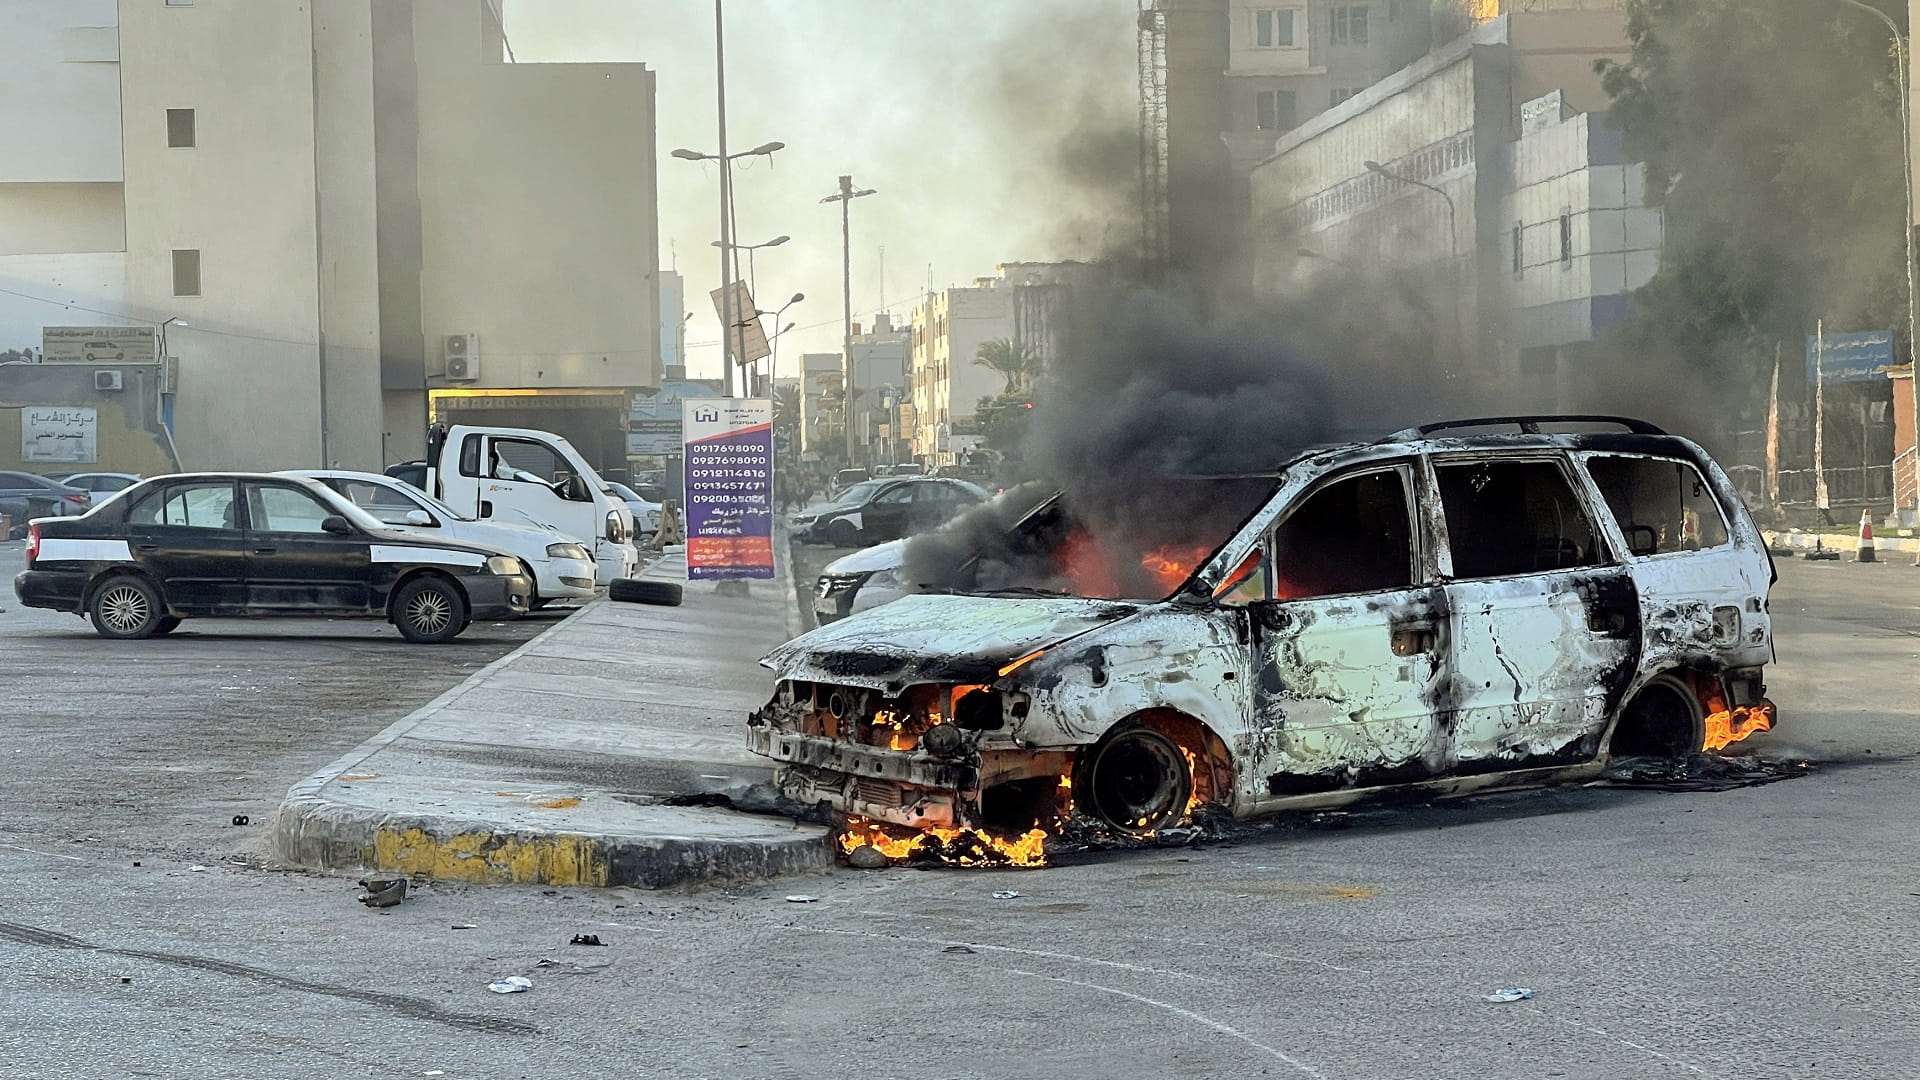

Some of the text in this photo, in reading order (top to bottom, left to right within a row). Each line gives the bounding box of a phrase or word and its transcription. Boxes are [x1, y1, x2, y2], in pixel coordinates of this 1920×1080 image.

[66, 412, 94, 426] مركز
[693, 445, 764, 453] 0917698090
[692, 469, 766, 477] 0912114816
